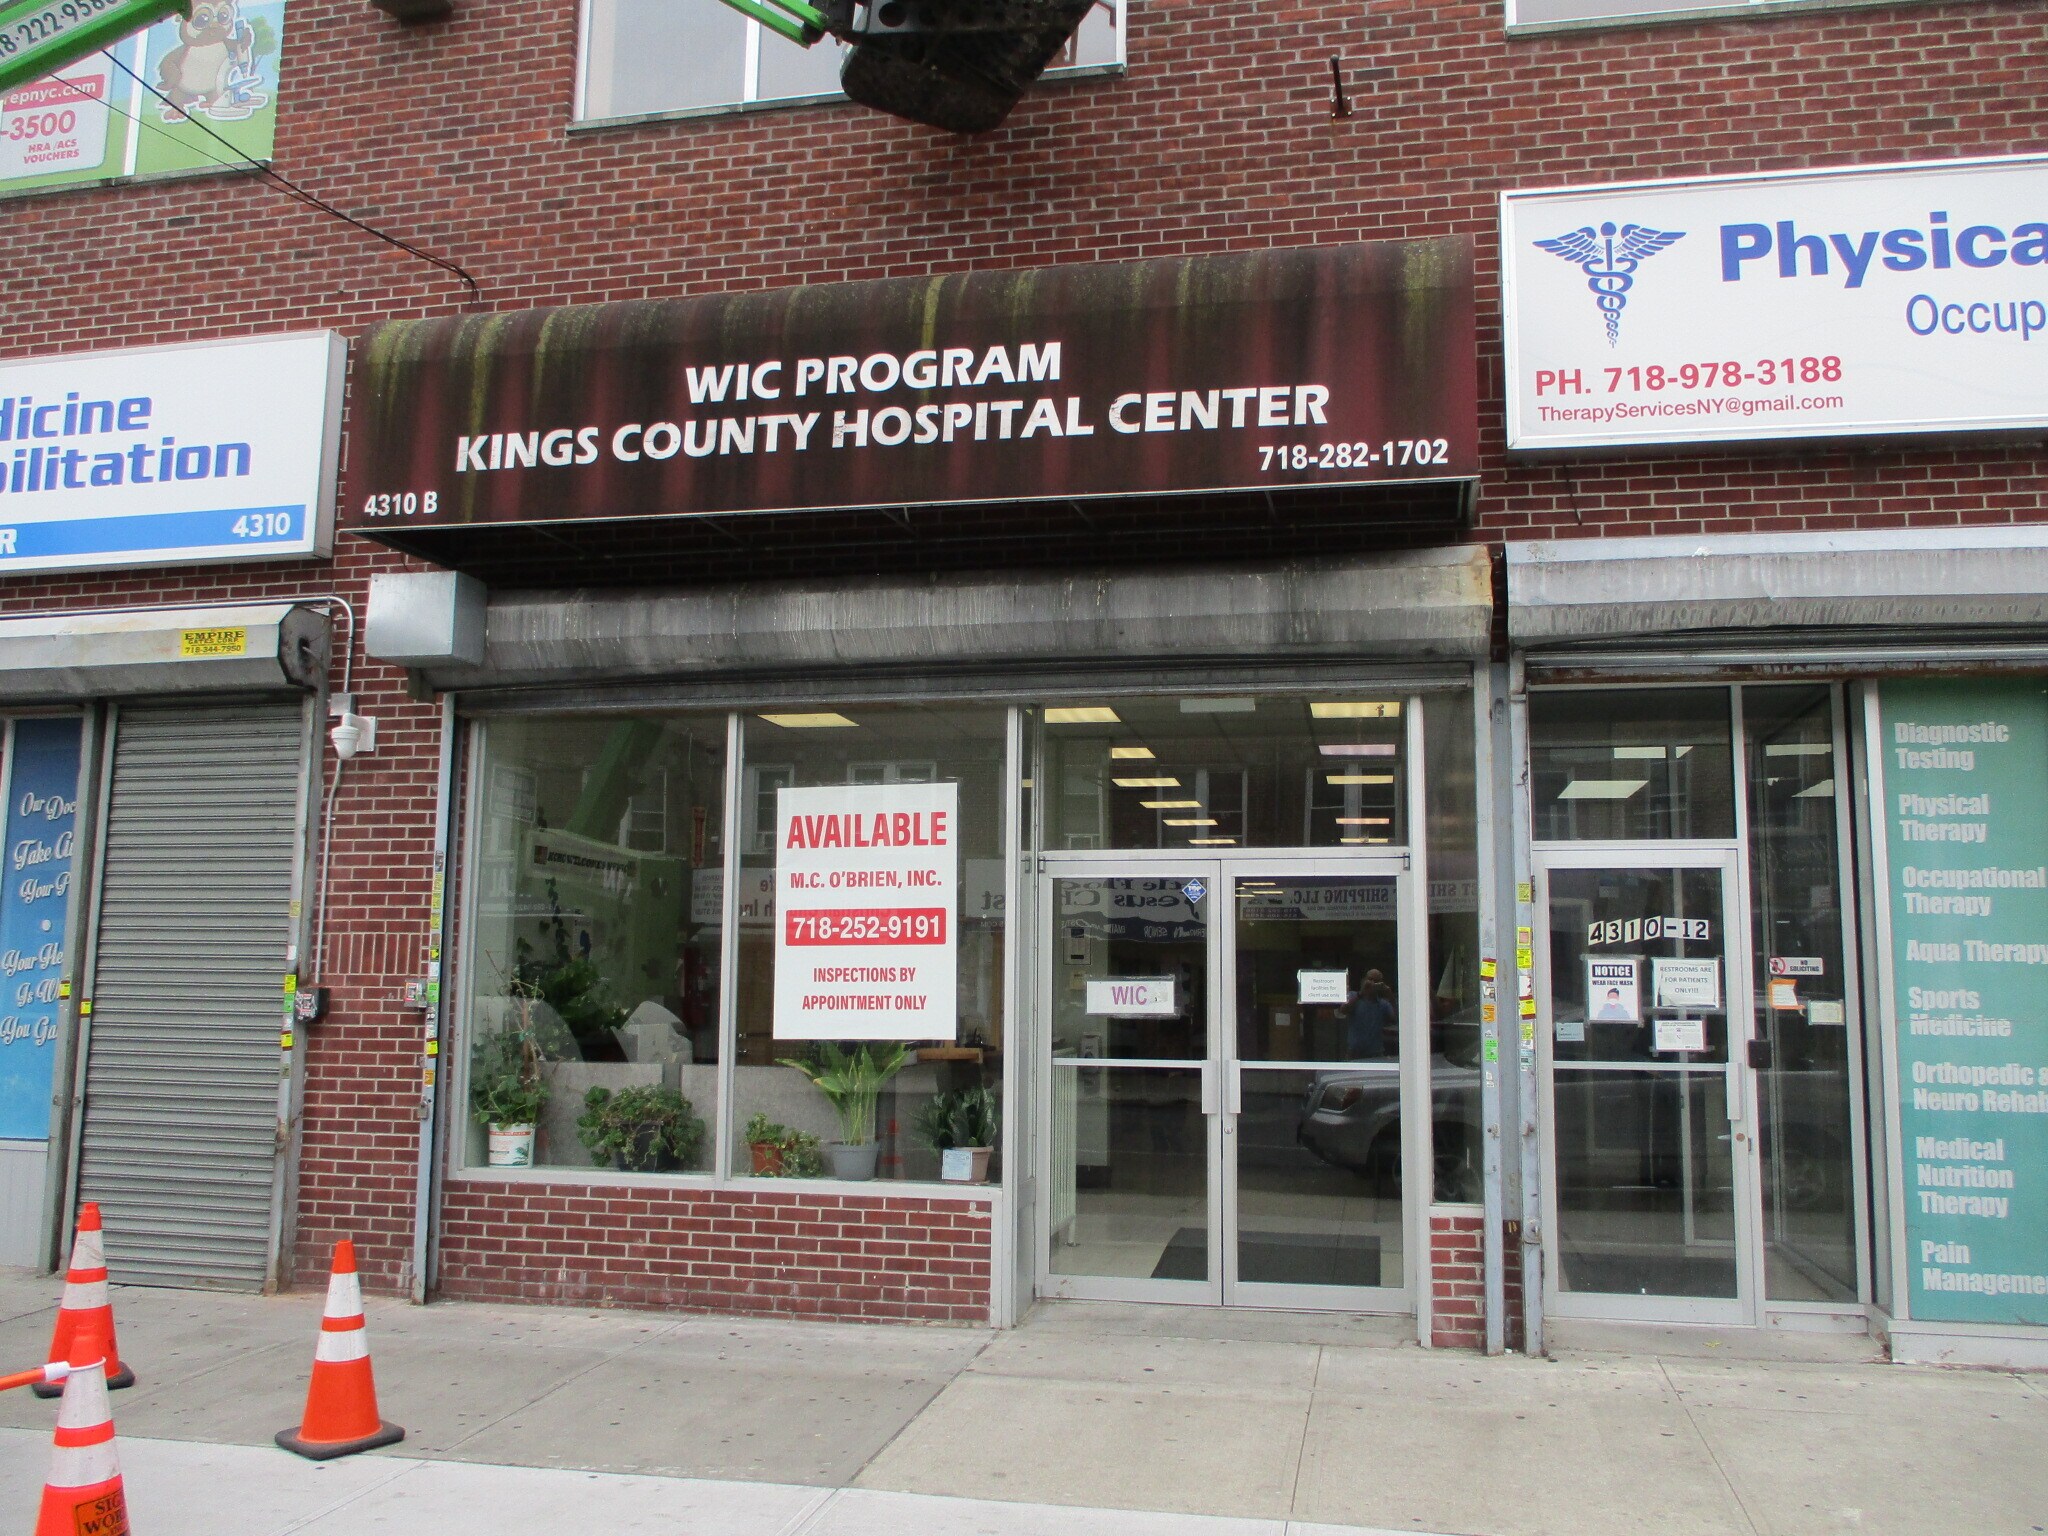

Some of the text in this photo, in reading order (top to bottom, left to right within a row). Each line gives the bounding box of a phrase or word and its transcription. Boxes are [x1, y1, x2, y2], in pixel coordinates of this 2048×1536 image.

[24, 149, 80, 164] VOUCHERS
[1720, 211, 2048, 288] Physica
[1906, 295, 2046, 341] Occup
[686, 342, 1061, 404] WIC PROGRAM
[1535, 355, 1843, 396] PH. 718-978-3188
[1537, 394, 1844, 422] TherapyServicesNY@gmail.com
[456, 385, 1330, 473] KINGS COUNTY HOSPITAL CENTER
[0, 437, 251, 493] ilitation
[1258, 439, 1449, 471] 718-282-1702
[364, 491, 438, 517] 4310 B
[232, 512, 292, 538] 4310
[185, 631, 245, 640] EMPIRE
[1894, 721, 2009, 745] Diagnostic
[1895, 747, 1974, 771] Testing
[20, 792, 46, 816] Our
[1898, 794, 1990, 818] Physical
[786, 811, 947, 849] AVAILABLE
[1899, 820, 1987, 843] Therapy
[14, 839, 52, 870] Take
[790, 870, 942, 888] M.C. O'BRIEN, INC.
[1902, 866, 2047, 890] Occupational
[1903, 892, 1991, 916] Therapy
[793, 915, 940, 939] 718-252-9191
[1590, 918, 1707, 942] 4310-12
[1906, 940, 2048, 964] Aqua Therapy
[813, 967, 916, 982] INSPECTIONS BY
[1594, 965, 1631, 976] NOTICE
[802, 995, 927, 1010] APPOINTMENT ONLY
[1112, 986, 1147, 1005] WIC
[1908, 986, 1981, 1011] Sports
[1910, 1013, 2012, 1037] Medicine
[1912, 1061, 2033, 1087] Orthopedic
[1913, 1087, 1979, 1112] Neuro
[1916, 1136, 2005, 1161] Medical
[1917, 1164, 2014, 1189] Nutrition
[1918, 1191, 2008, 1218] Therapy
[1920, 1240, 1970, 1264] Pain
[1922, 1267, 2048, 1296] Manageme
